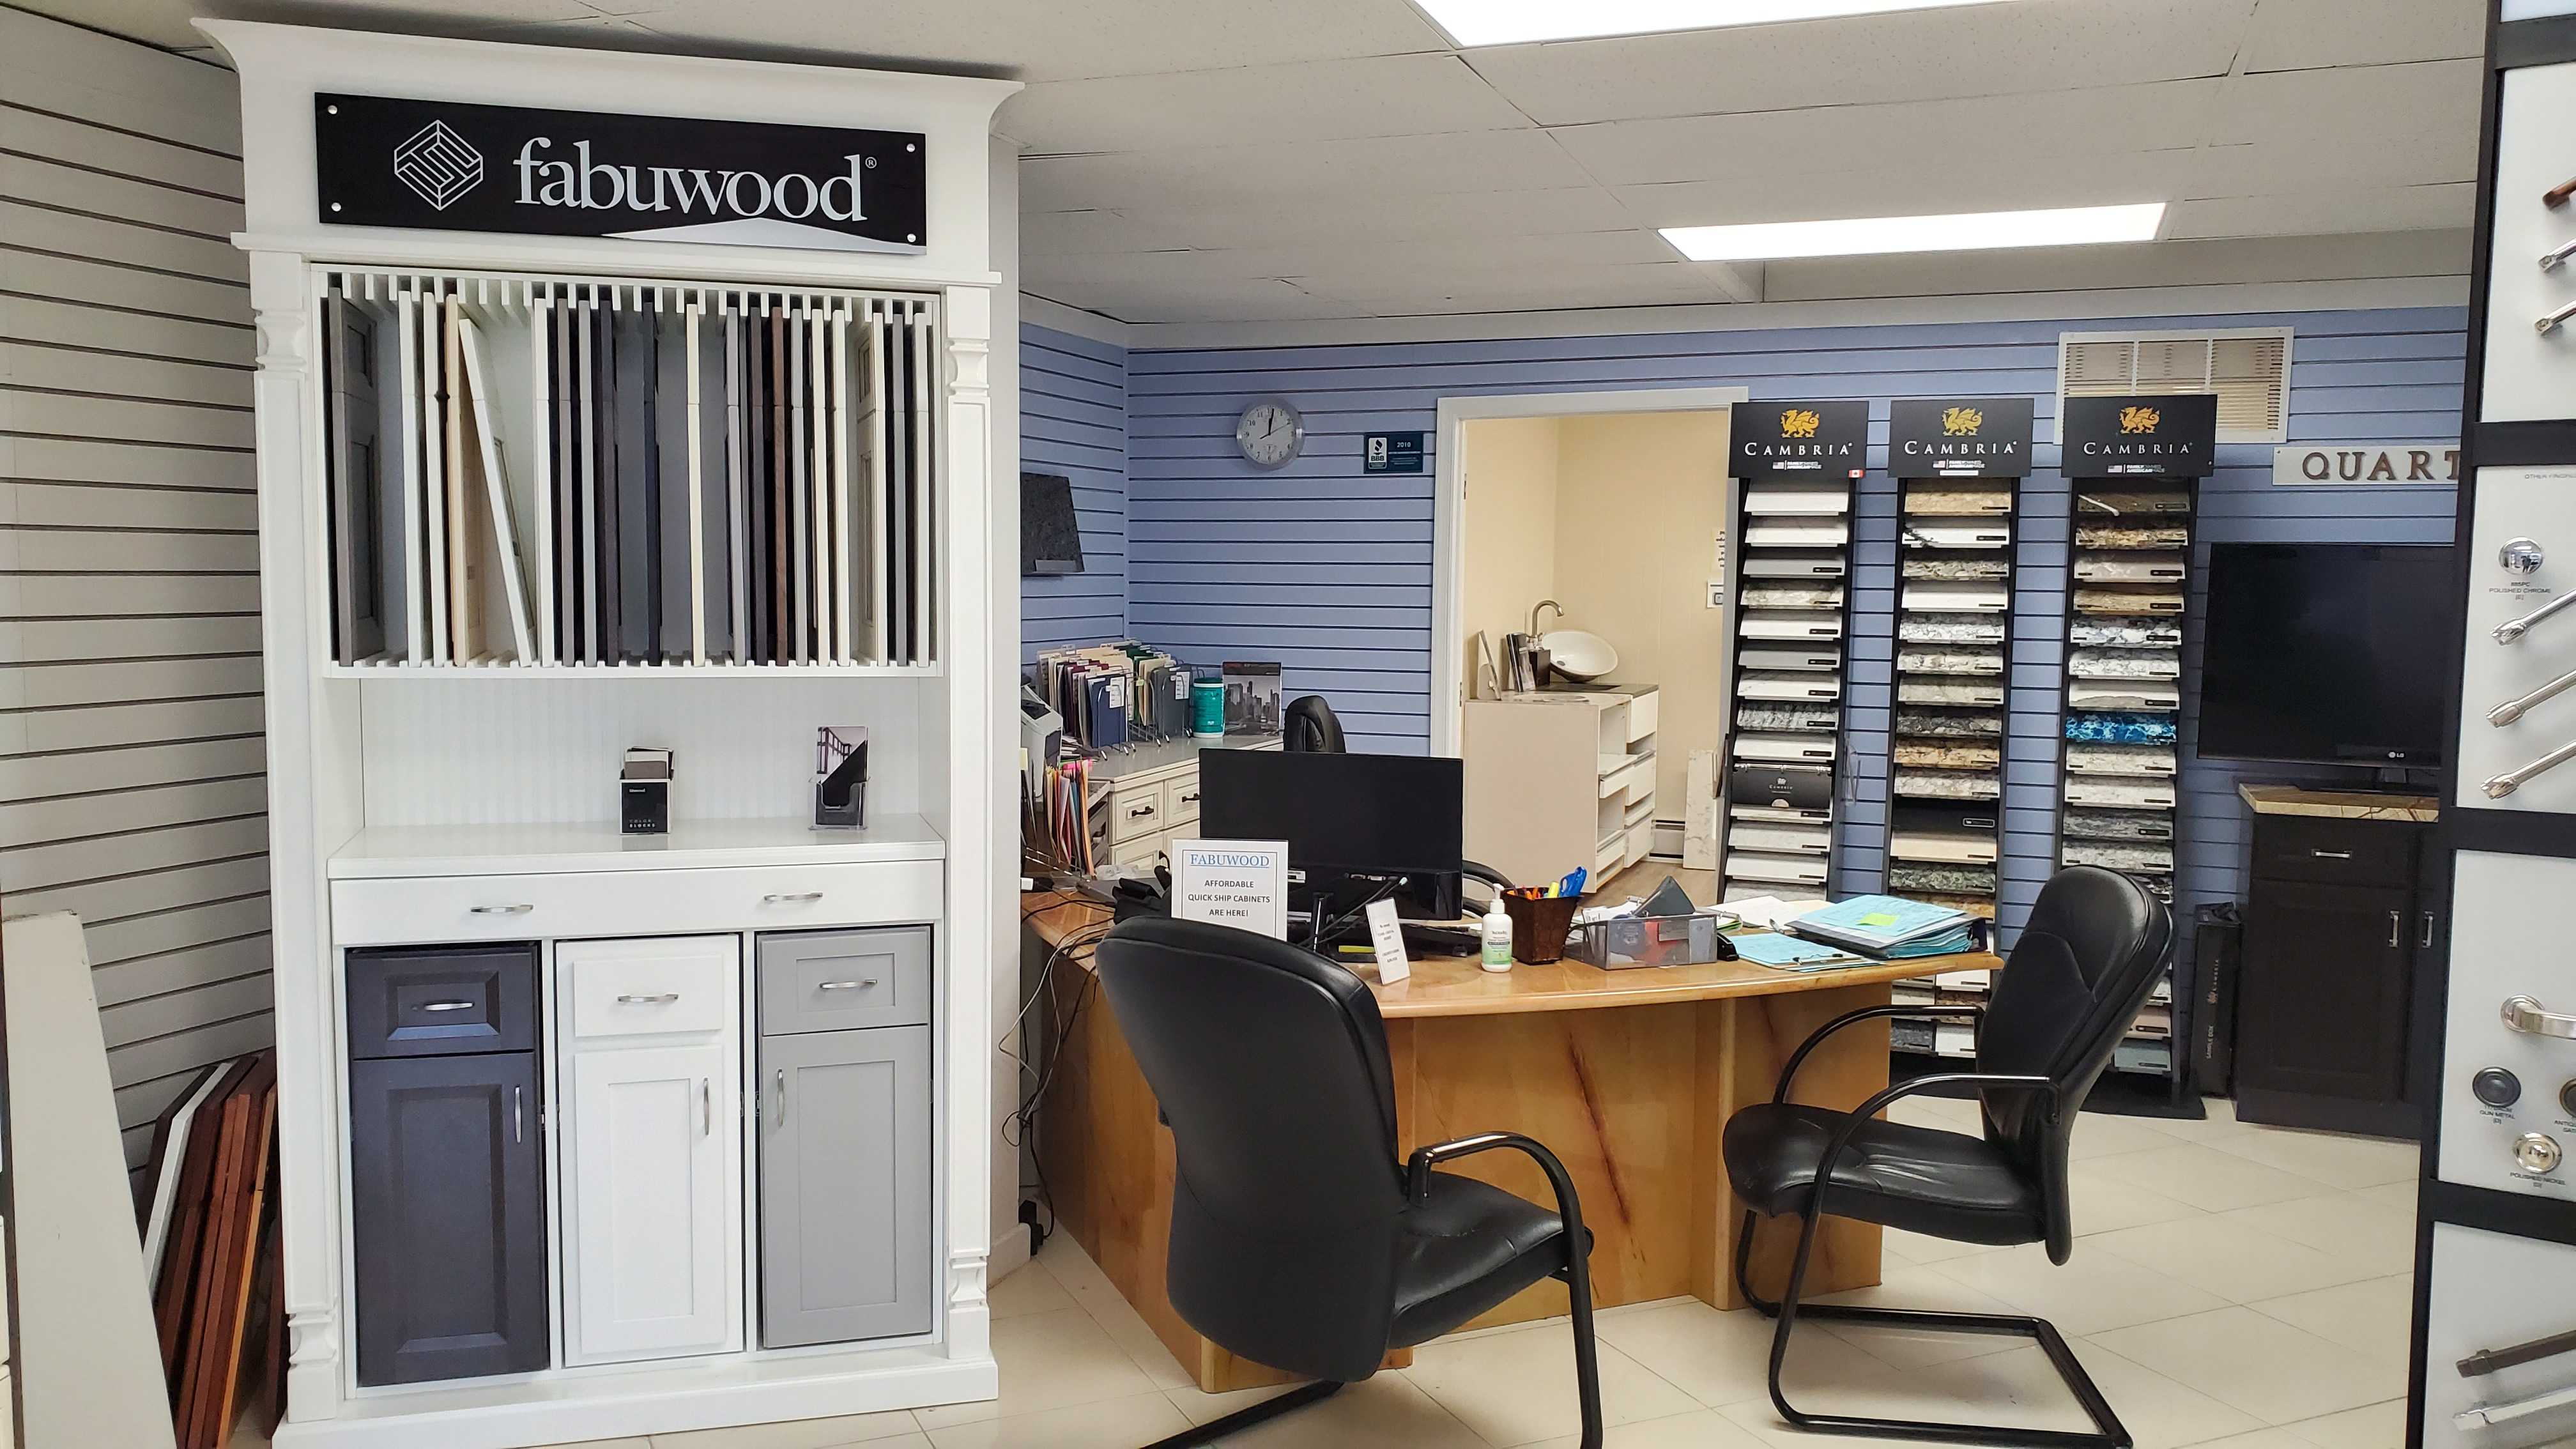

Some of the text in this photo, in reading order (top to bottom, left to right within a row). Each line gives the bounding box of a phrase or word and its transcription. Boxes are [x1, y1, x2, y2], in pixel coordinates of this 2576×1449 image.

[513, 137, 868, 222] fabuwood
[1745, 442, 1849, 456] CAMBRIA
[1905, 441, 2014, 454] CAMBRIA
[2083, 442, 2189, 454] CAMBRIA
[1190, 854, 1269, 866] FABUWOOD
[1204, 880, 1254, 888] AFFORDABLE
